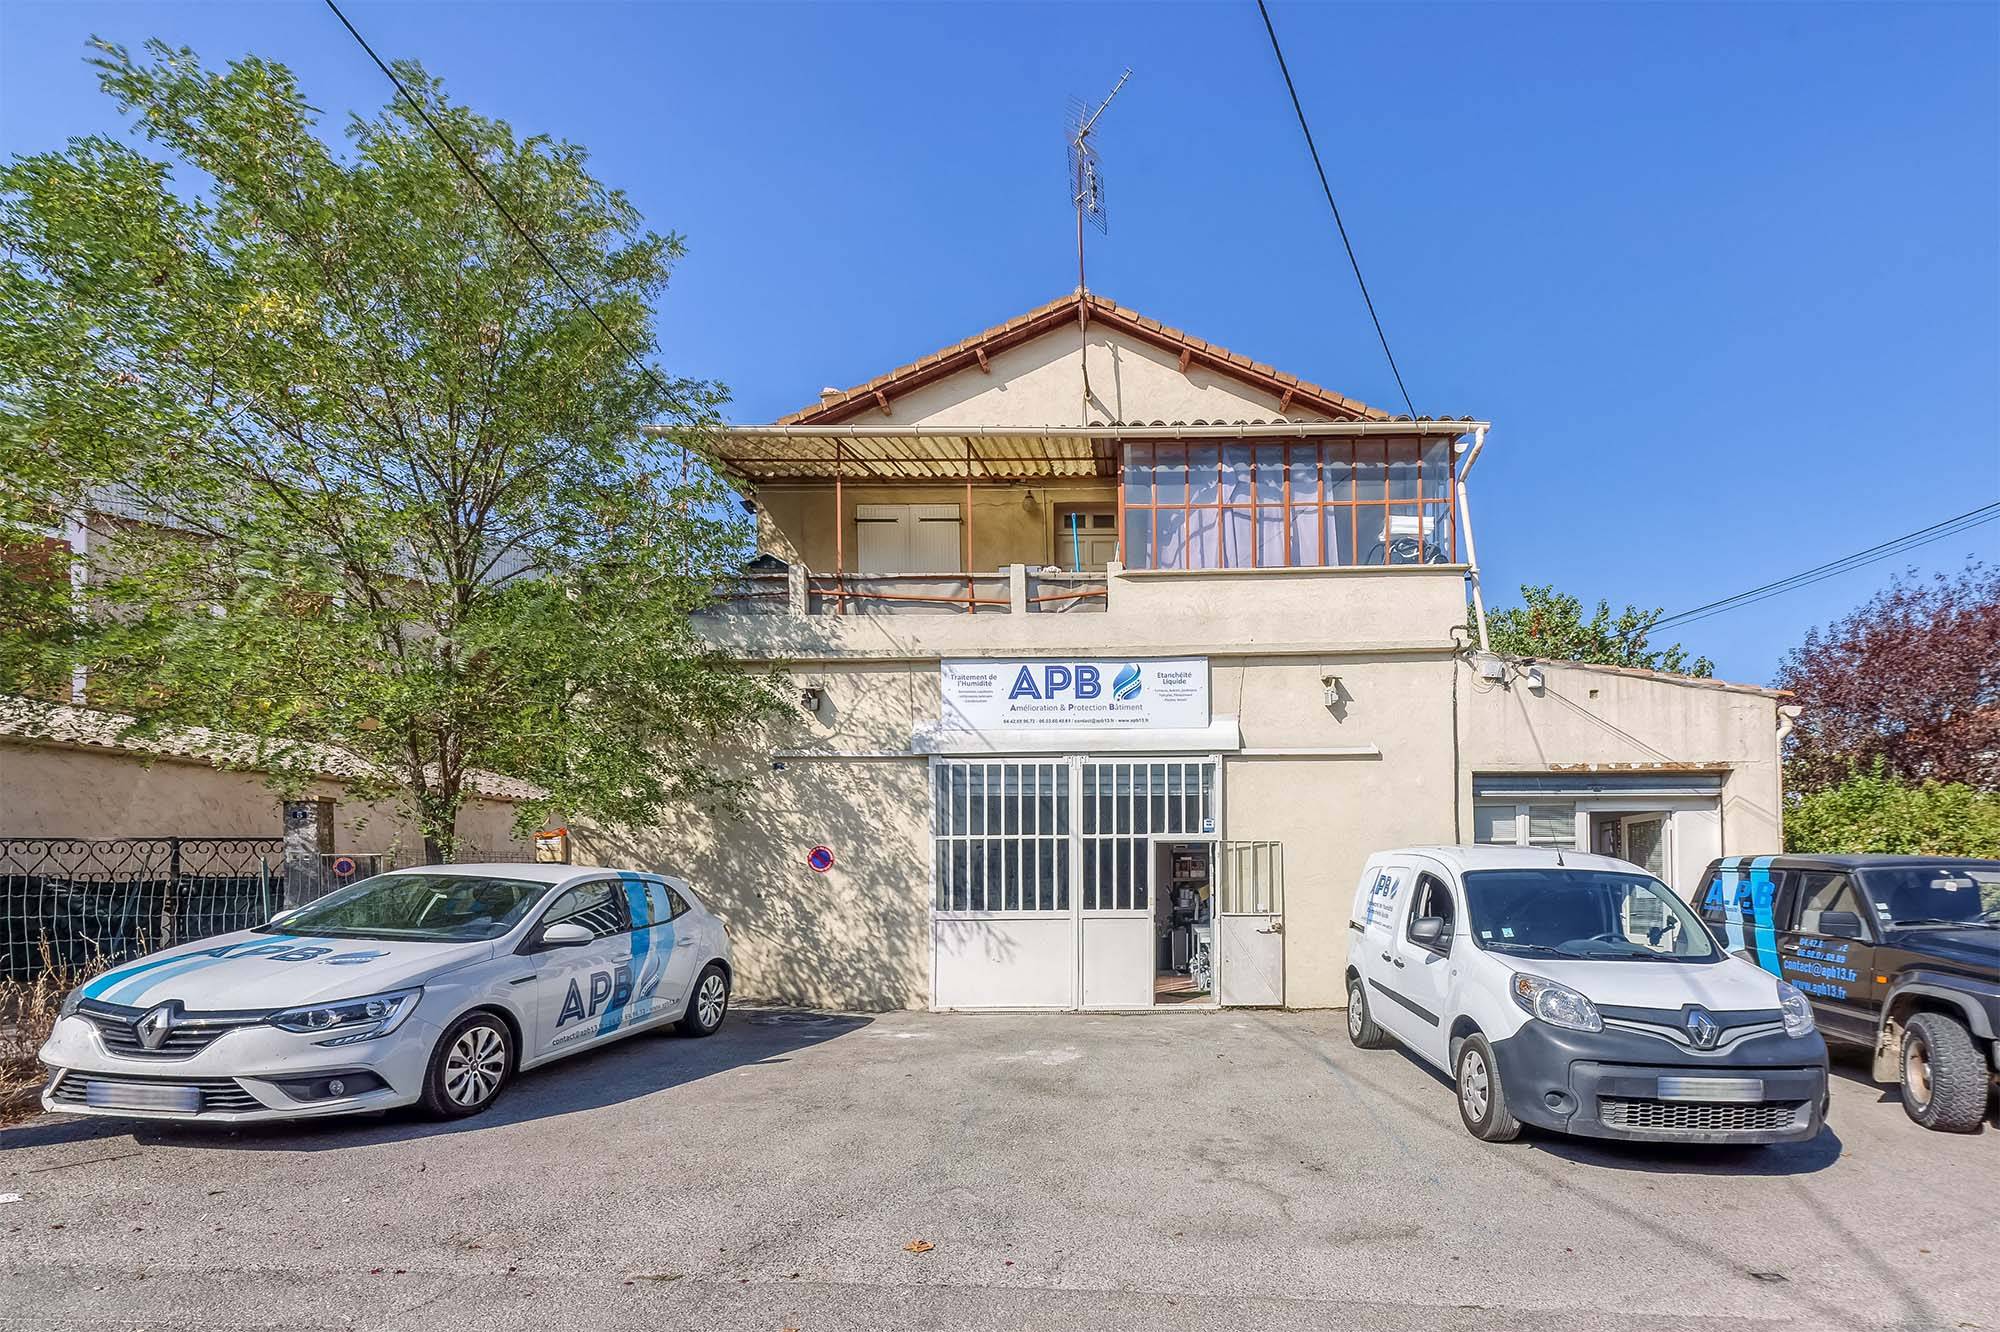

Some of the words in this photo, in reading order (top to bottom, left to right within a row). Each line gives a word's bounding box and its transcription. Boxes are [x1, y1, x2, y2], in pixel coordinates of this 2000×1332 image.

[1008, 665, 1101, 699] APB
[1010, 704, 1058, 712] Amélioration
[1060, 704, 1066, 712] &
[1068, 704, 1107, 712] Protection
[1109, 703, 1143, 711] Bâtiment
[555, 964, 633, 1028] APB
